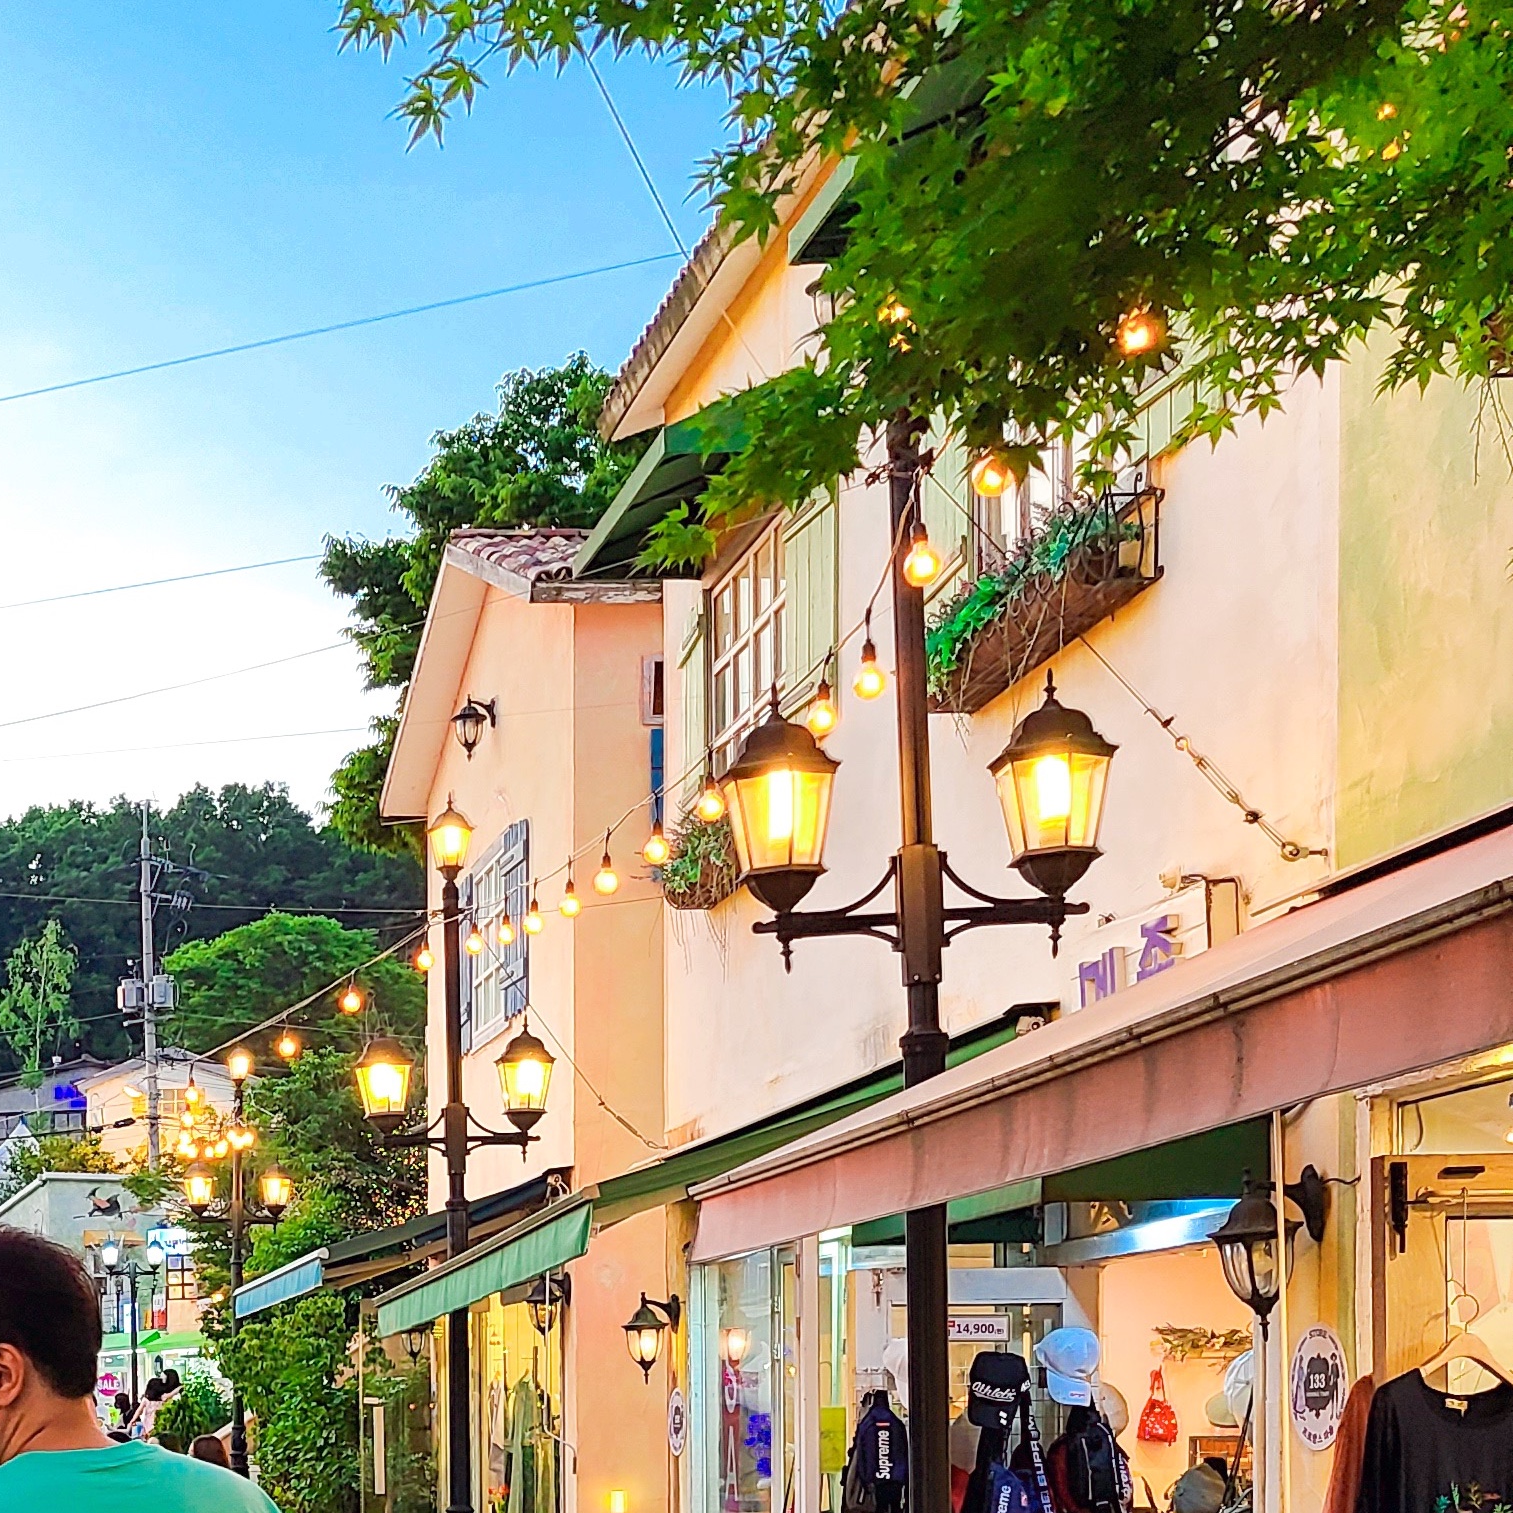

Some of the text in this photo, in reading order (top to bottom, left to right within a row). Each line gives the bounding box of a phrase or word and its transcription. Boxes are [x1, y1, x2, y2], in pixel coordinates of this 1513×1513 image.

[956, 1323, 994, 1335] 14,900
[97, 1379, 120, 1390] SALE
[1309, 1373, 1326, 1389] 133
[876, 1430, 894, 1480] Supreme
